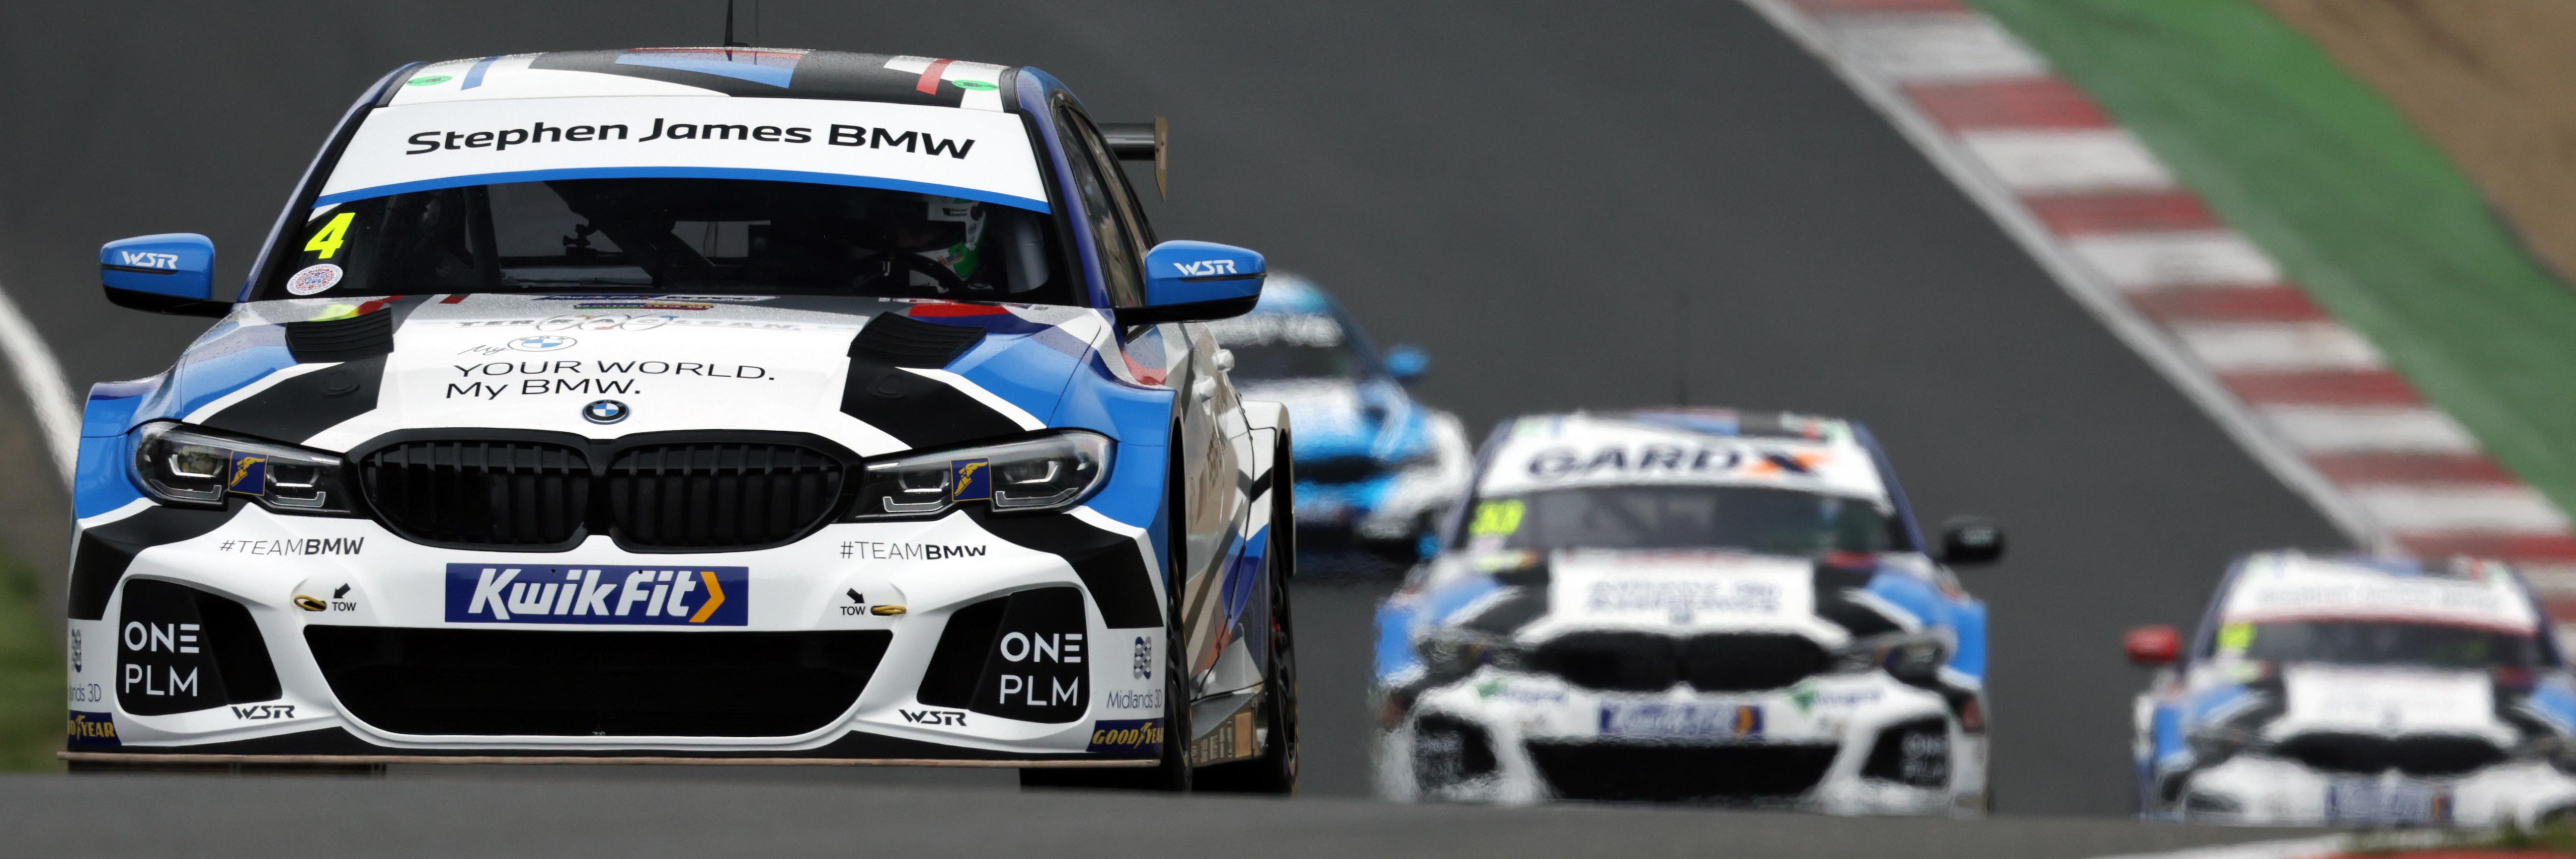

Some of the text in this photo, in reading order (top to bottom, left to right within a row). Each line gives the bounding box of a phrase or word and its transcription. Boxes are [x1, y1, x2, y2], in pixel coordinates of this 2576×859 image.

[405, 118, 976, 159] Stephen James BMW
[304, 212, 356, 259] 4
[122, 251, 179, 270] WSR
[1173, 259, 1237, 276] WSR
[457, 344, 510, 356] My
[455, 360, 775, 381] YOUR WORLD.
[446, 379, 641, 400] My BMW.
[1528, 442, 1831, 479] GARDX
[219, 537, 364, 555] #TEAMBMW
[840, 541, 986, 560] #TEAMBMW
[468, 568, 697, 621] KwikFit
[332, 602, 357, 612] TOW
[840, 606, 866, 616] TOW
[124, 621, 200, 654] ONE
[1000, 631, 1083, 663] ONE
[126, 663, 198, 697] PLM
[999, 674, 1079, 706] PLM
[87, 683, 102, 702] 3D
[1106, 689, 1163, 709] Midlands 3D
[231, 704, 296, 720] WSR
[898, 709, 967, 726] WSR
